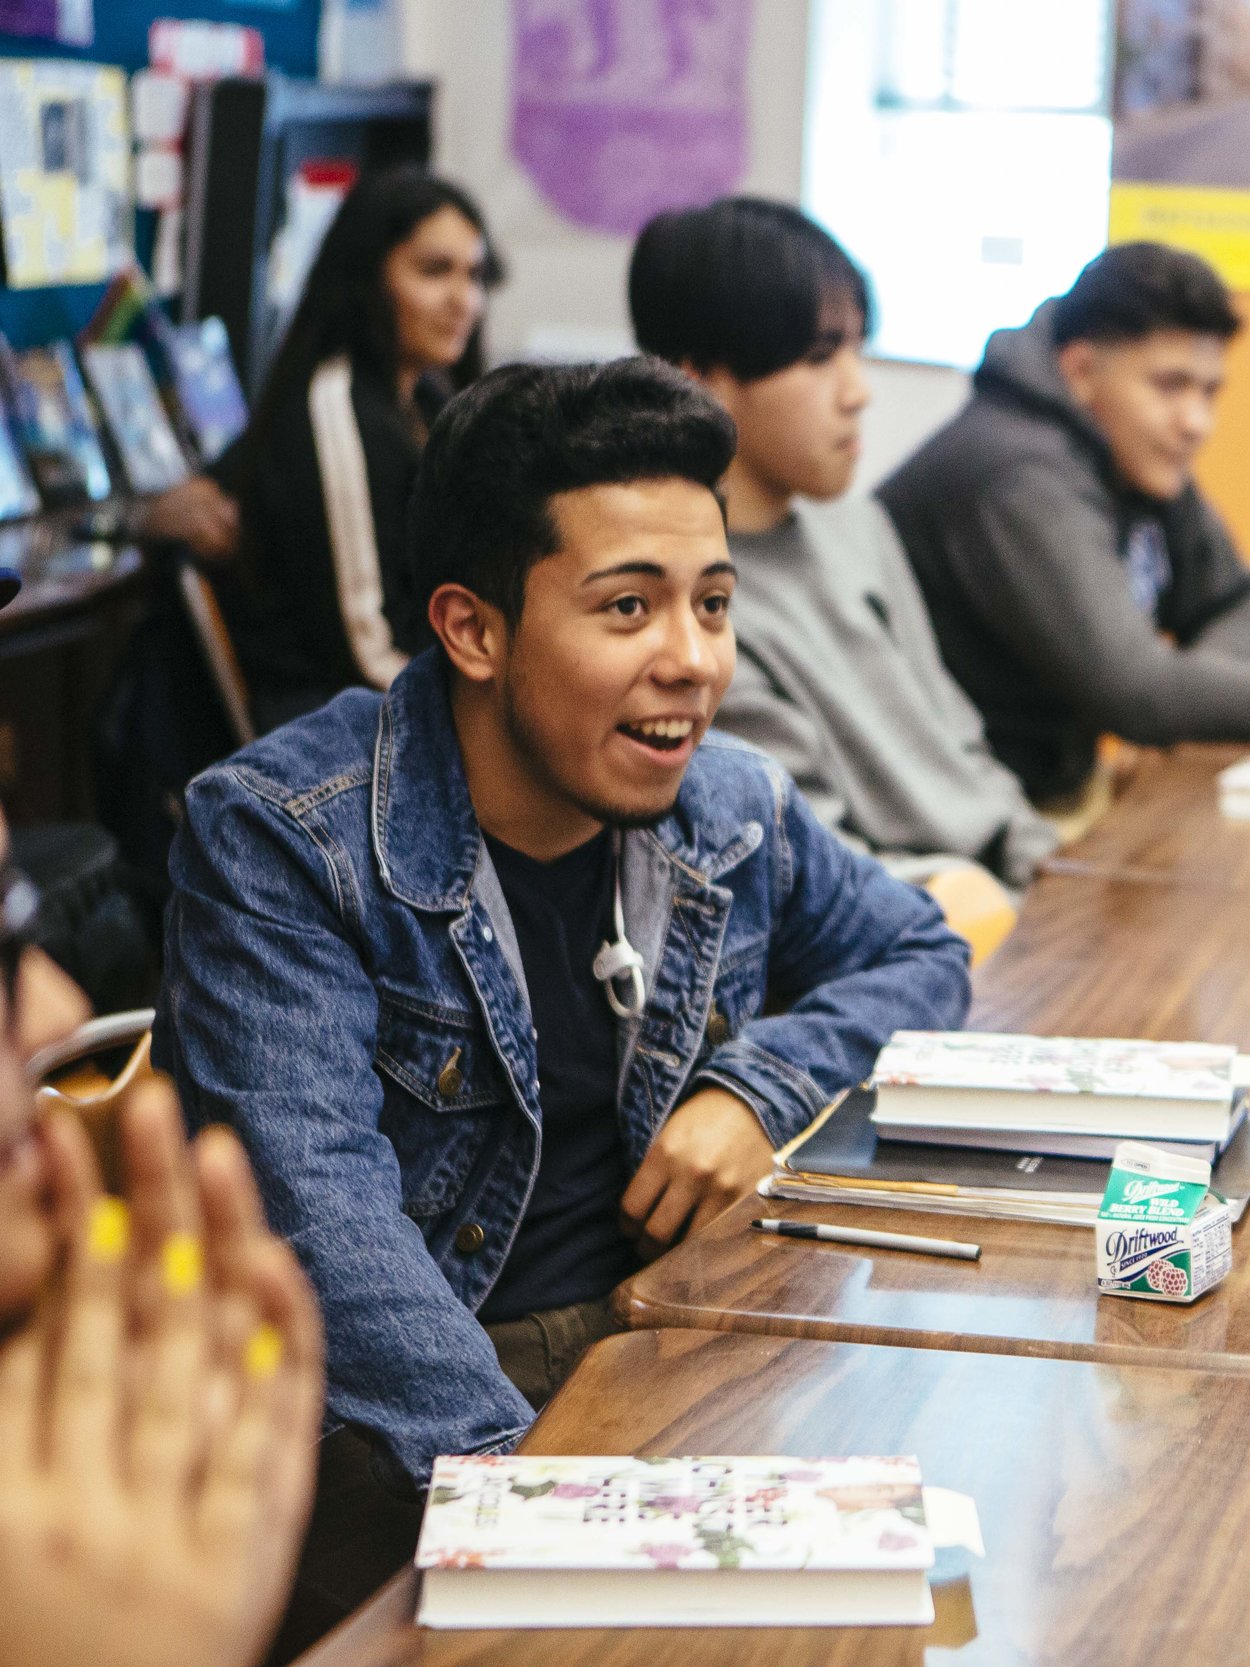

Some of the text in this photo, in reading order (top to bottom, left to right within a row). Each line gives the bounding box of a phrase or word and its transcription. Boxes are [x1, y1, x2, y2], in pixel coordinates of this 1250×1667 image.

[1149, 1197, 1180, 1208] WILD
[1109, 1203, 1147, 1214] BERRY
[1147, 1206, 1185, 1217] BLEND
[1105, 1226, 1179, 1265] Driftwood
[1120, 1257, 1136, 1269] SINCE
